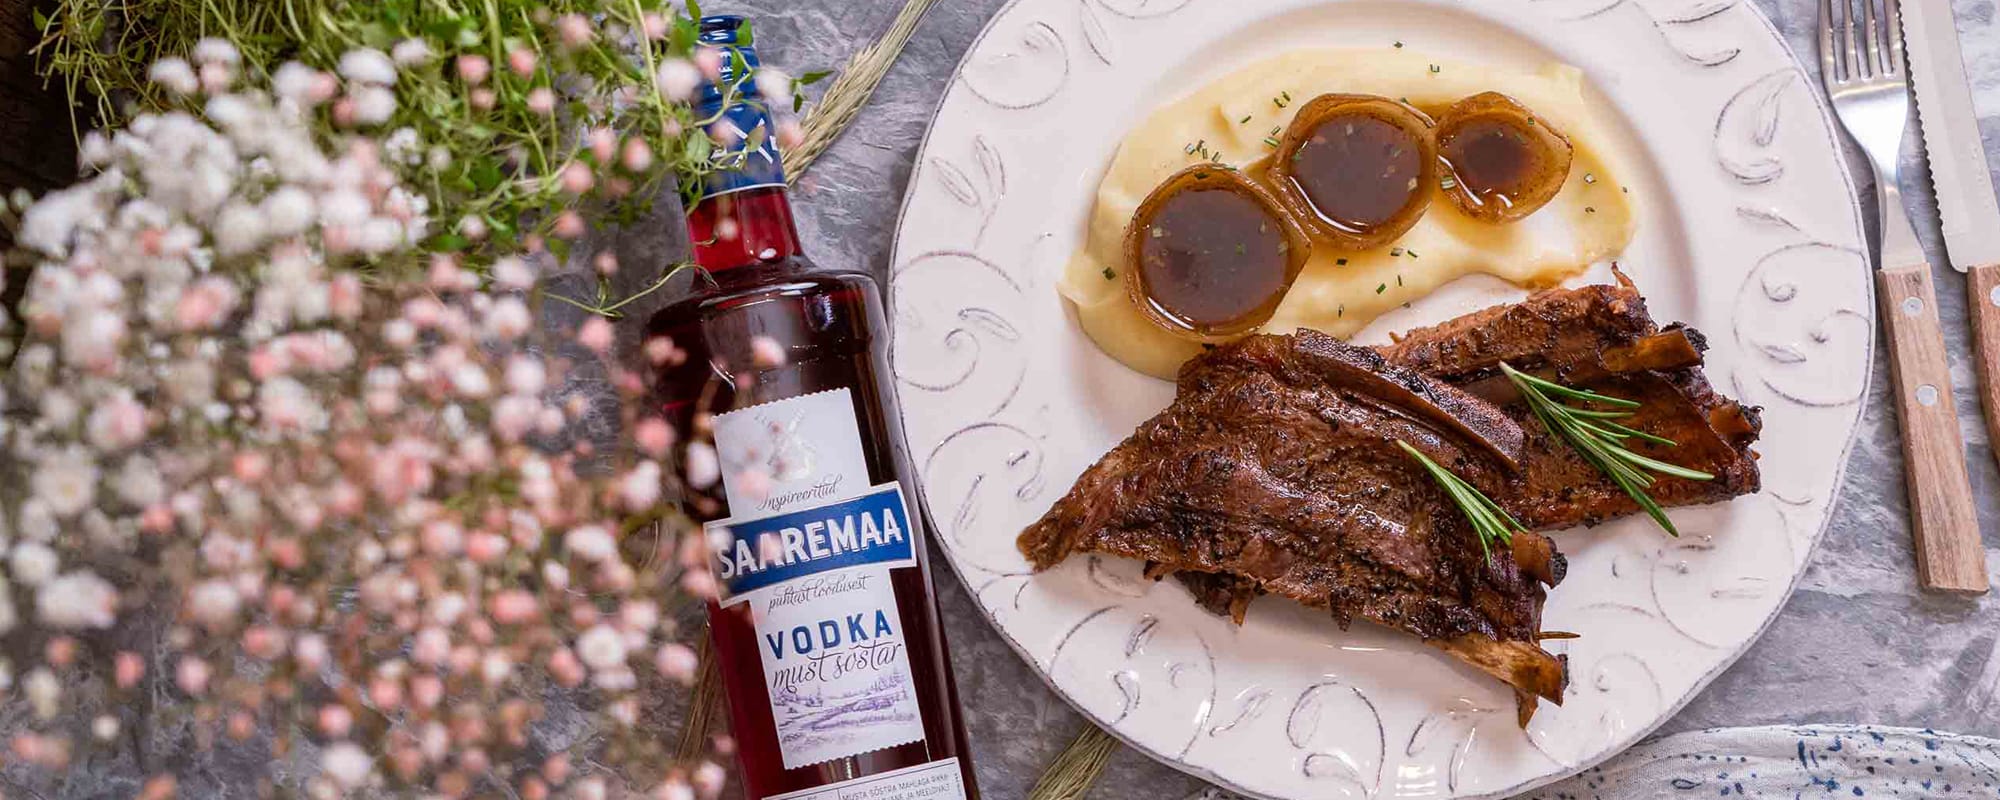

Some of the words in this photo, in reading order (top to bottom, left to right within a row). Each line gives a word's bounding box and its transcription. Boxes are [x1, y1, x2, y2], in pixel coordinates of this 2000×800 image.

[756, 473, 843, 512] Inspireeritud
[715, 507, 904, 580] SAAREMAA
[768, 582, 816, 614] puhtast
[813, 572, 875, 598] loodusest
[766, 609, 893, 660] VODKA
[773, 650, 842, 694] must
